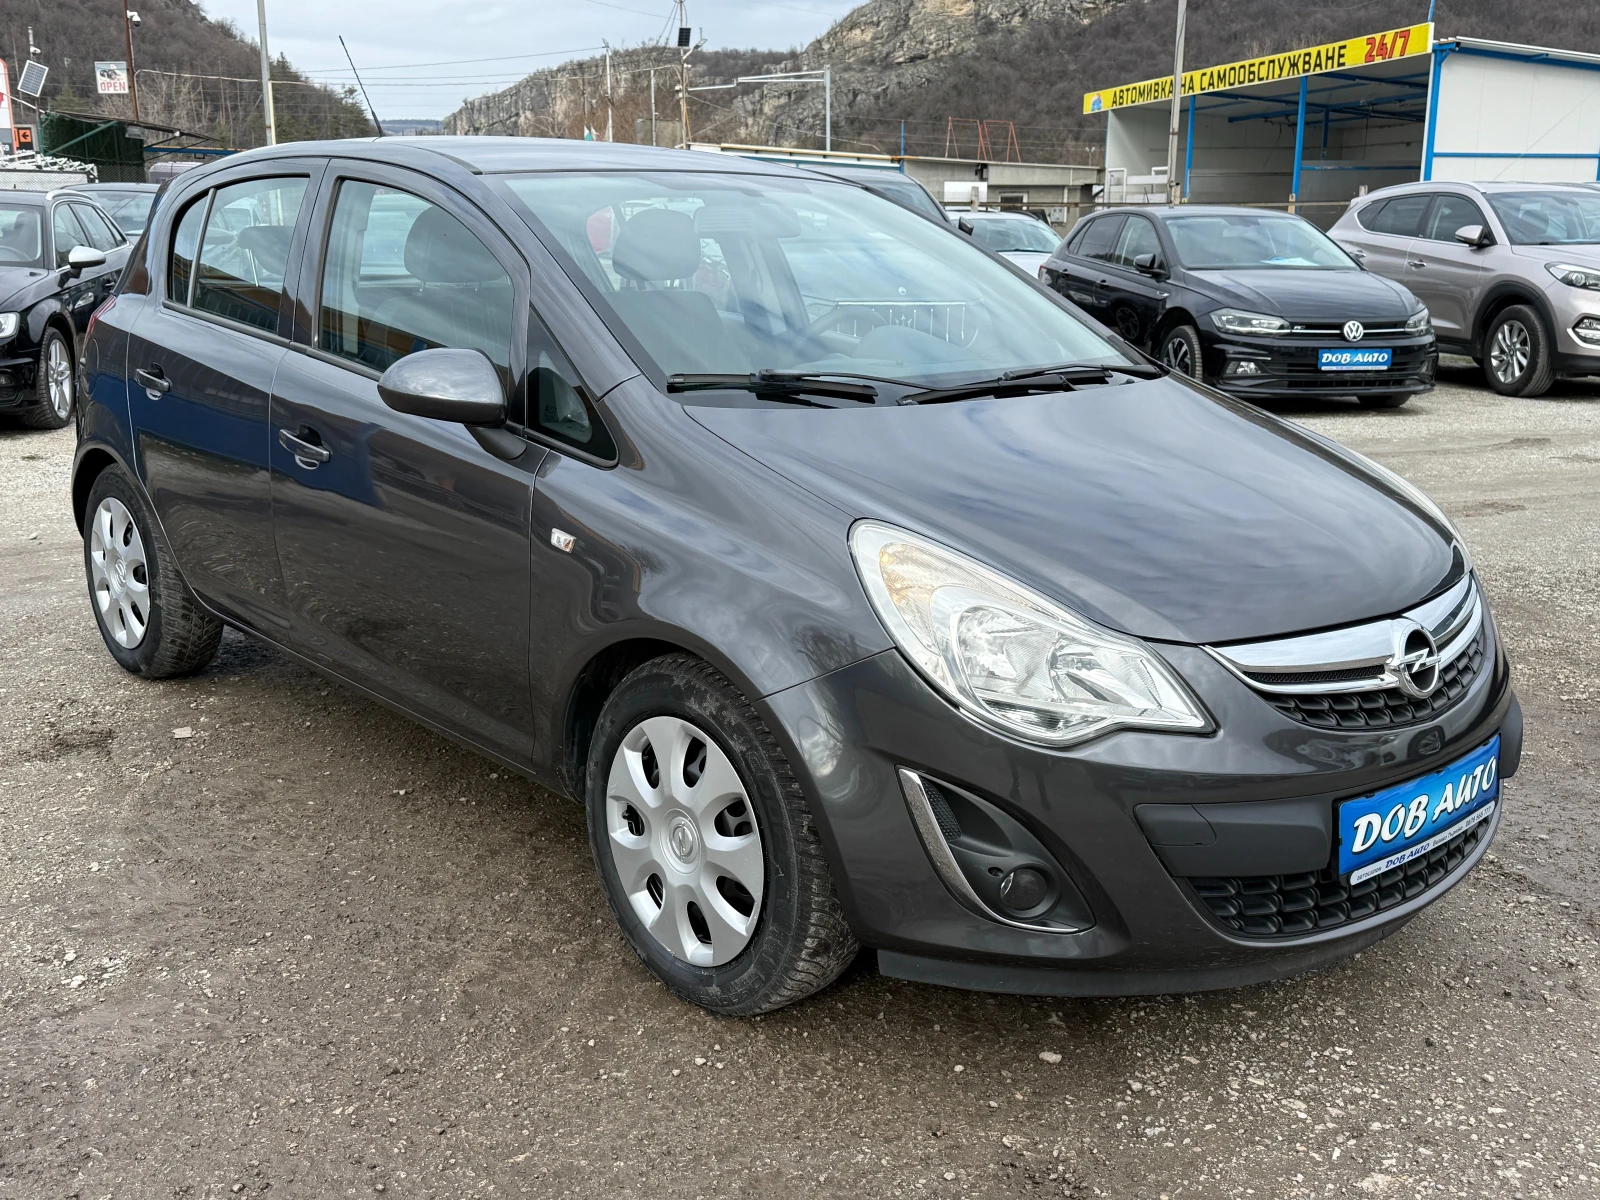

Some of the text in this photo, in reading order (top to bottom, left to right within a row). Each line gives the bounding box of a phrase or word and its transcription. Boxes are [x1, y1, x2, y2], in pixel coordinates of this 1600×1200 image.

[1111, 29, 1411, 107] АВТОМИВКА НА САМООБСЛУЖВАНЕ 24/7
[100, 81, 126, 92] OPEN
[1321, 352, 1388, 365] DOB AUTO
[1352, 755, 1497, 853] DOB AUTO
[1385, 853, 1406, 869] DOB
[1406, 843, 1430, 860] AUTO
